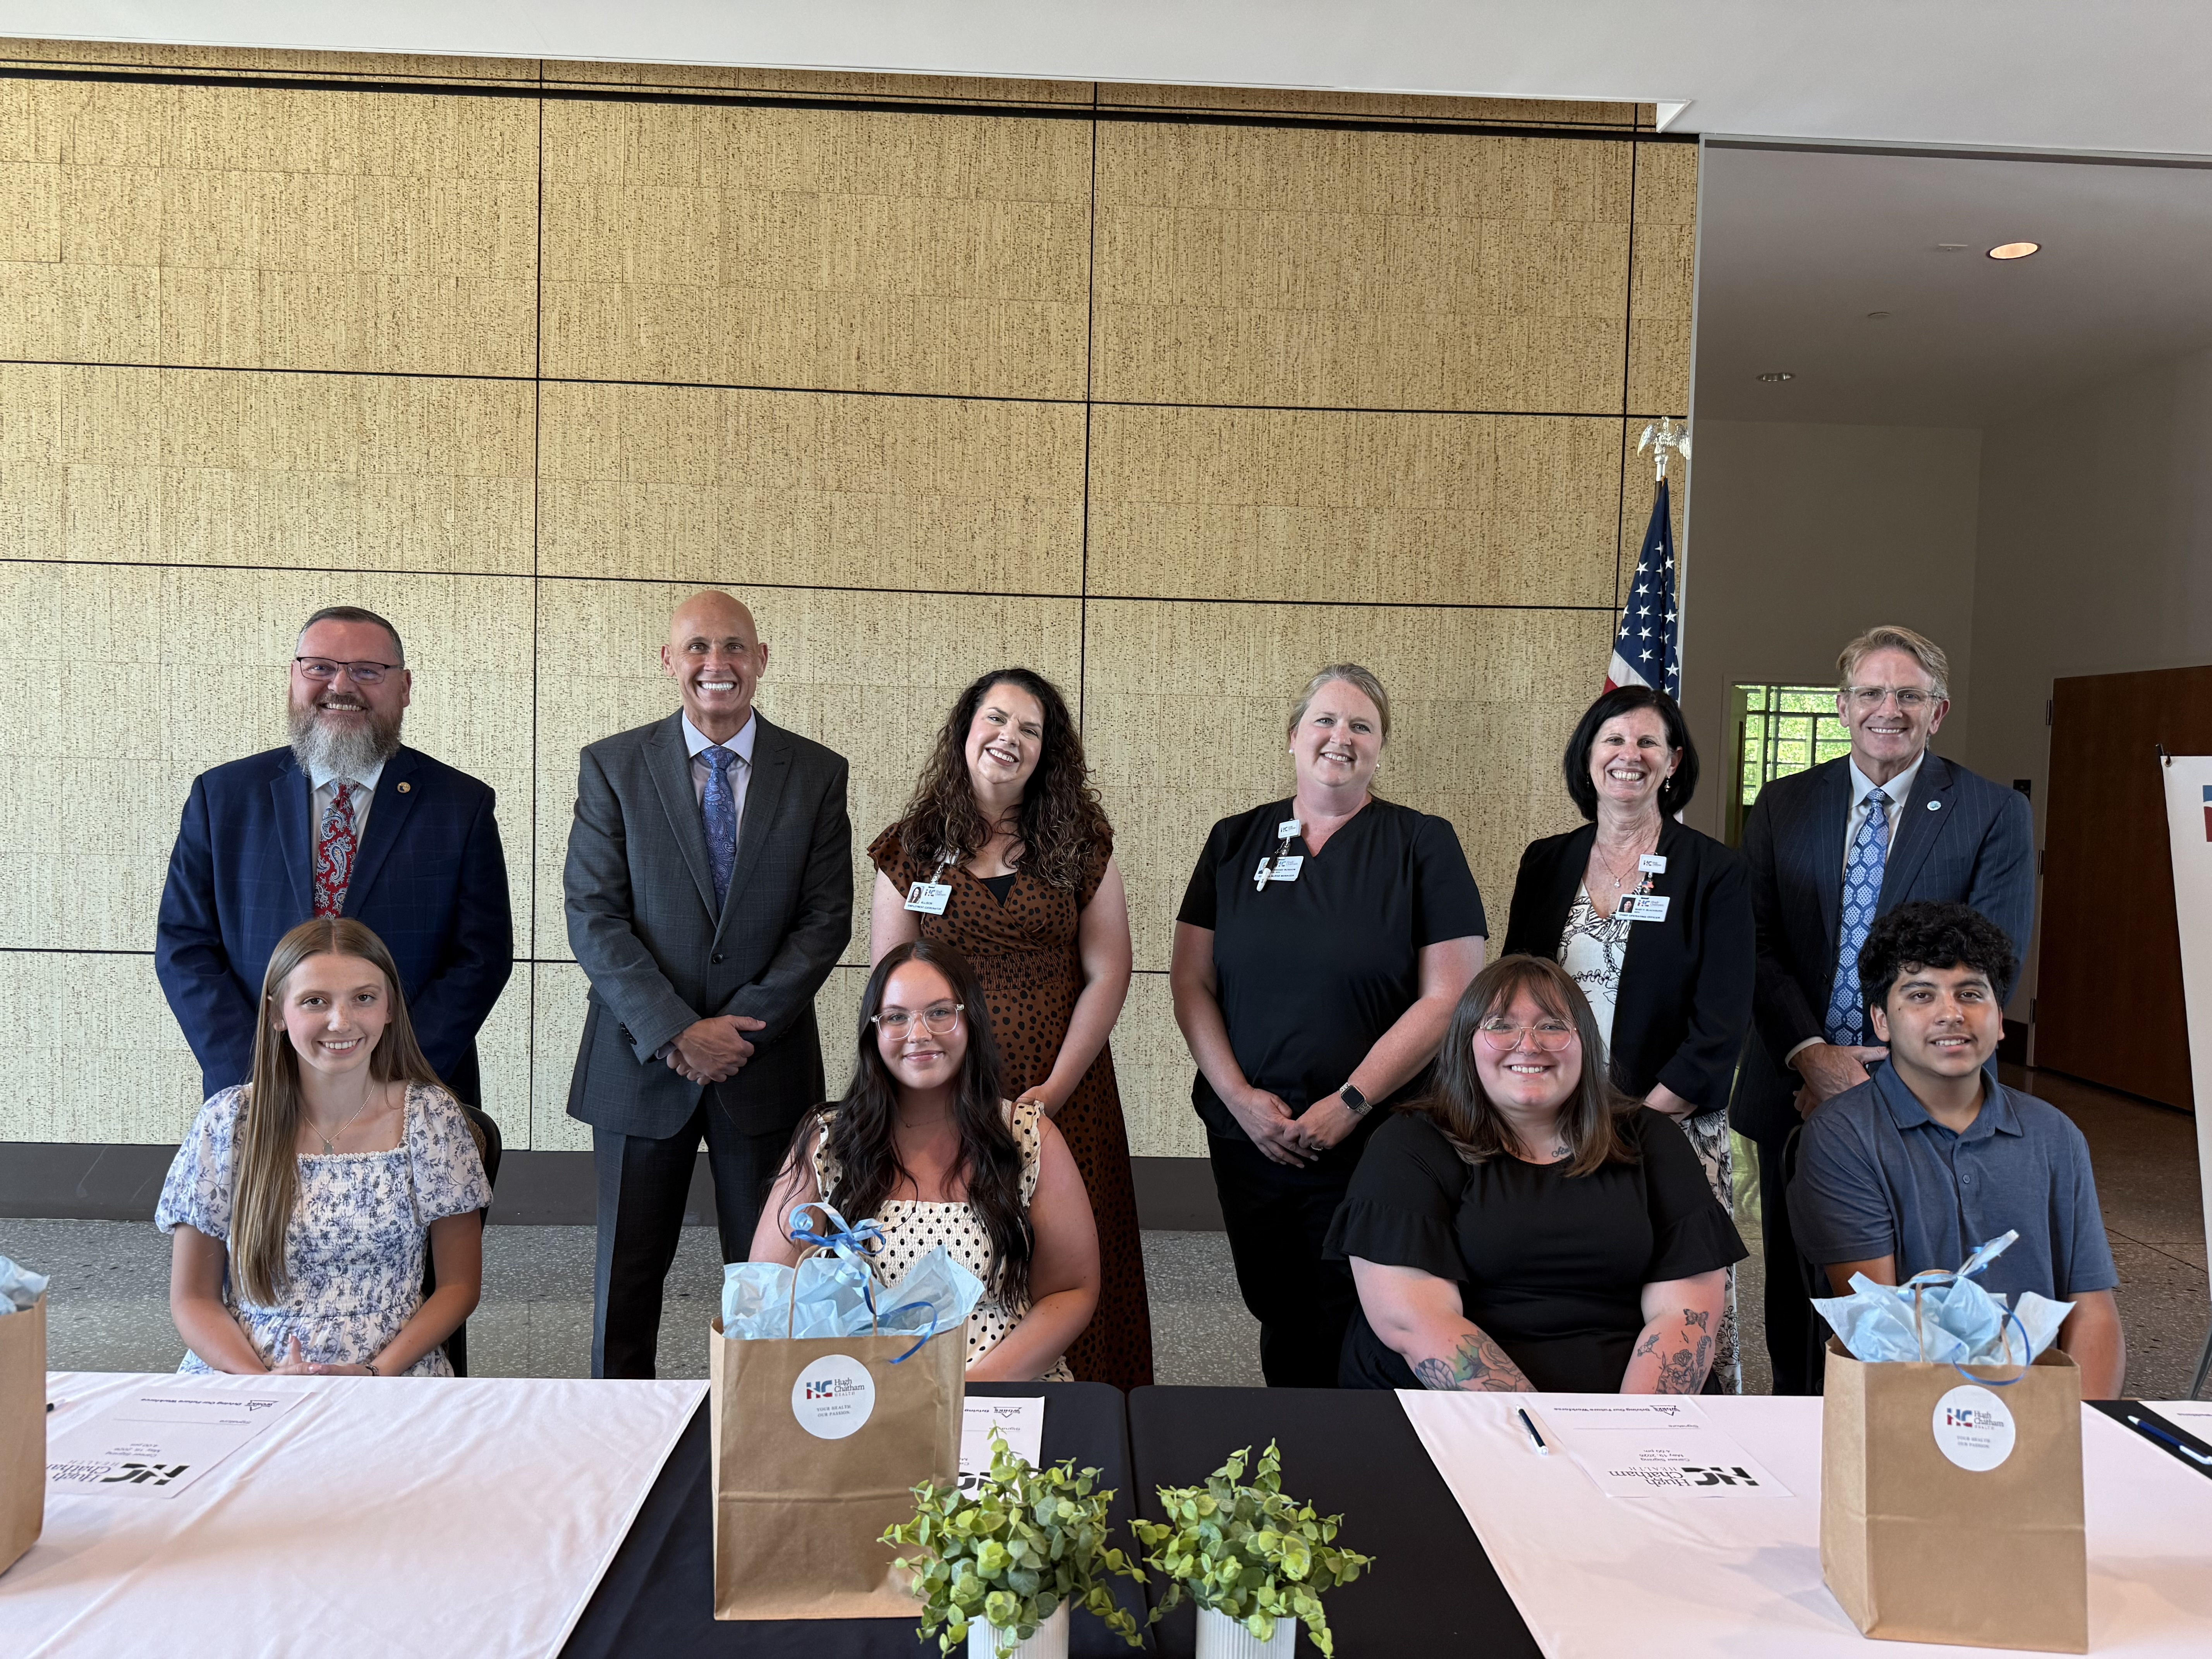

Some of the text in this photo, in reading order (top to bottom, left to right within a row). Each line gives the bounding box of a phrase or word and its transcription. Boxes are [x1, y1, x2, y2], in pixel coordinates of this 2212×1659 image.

[834, 1377, 852, 1387] Hugh
[806, 1379, 833, 1400] HC
[834, 1384, 865, 1393] Chatham
[1946, 1408, 1973, 1428] HC
[1974, 1410, 1992, 1419] Hugh
[1974, 1417, 2004, 1427] Chatham
[52, 1472, 101, 1483] Hugh
[100, 1463, 191, 1485] HC
[1608, 1470, 1684, 1479] Chatham
[1681, 1467, 1760, 1486] HC
[1644, 1477, 1693, 1487] Hugh
